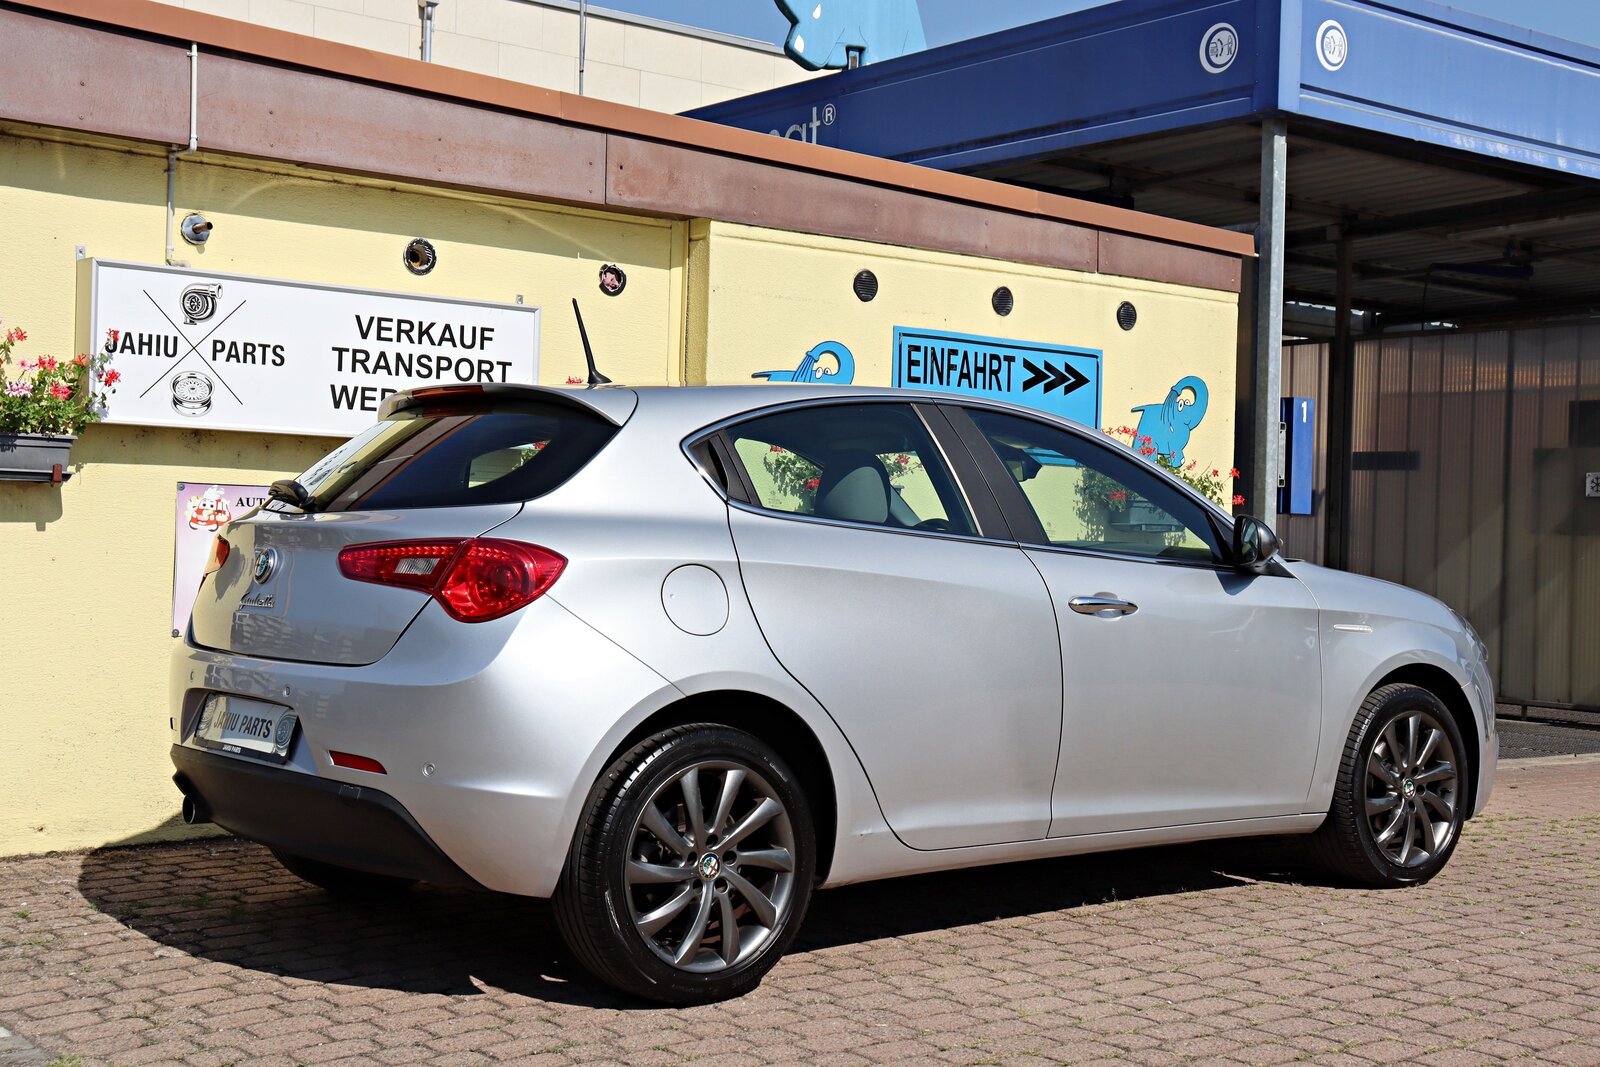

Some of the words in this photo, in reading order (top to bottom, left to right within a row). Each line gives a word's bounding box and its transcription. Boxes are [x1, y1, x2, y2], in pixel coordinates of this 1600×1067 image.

[104, 331, 178, 358] JAHIU
[211, 339, 286, 367] PARTS
[355, 314, 495, 351] VERKAUF
[331, 346, 513, 383] TRANSPORT
[907, 344, 1016, 393] EINFAHRT
[1301, 401, 1308, 423] 1
[238, 715, 273, 739] PARTS
